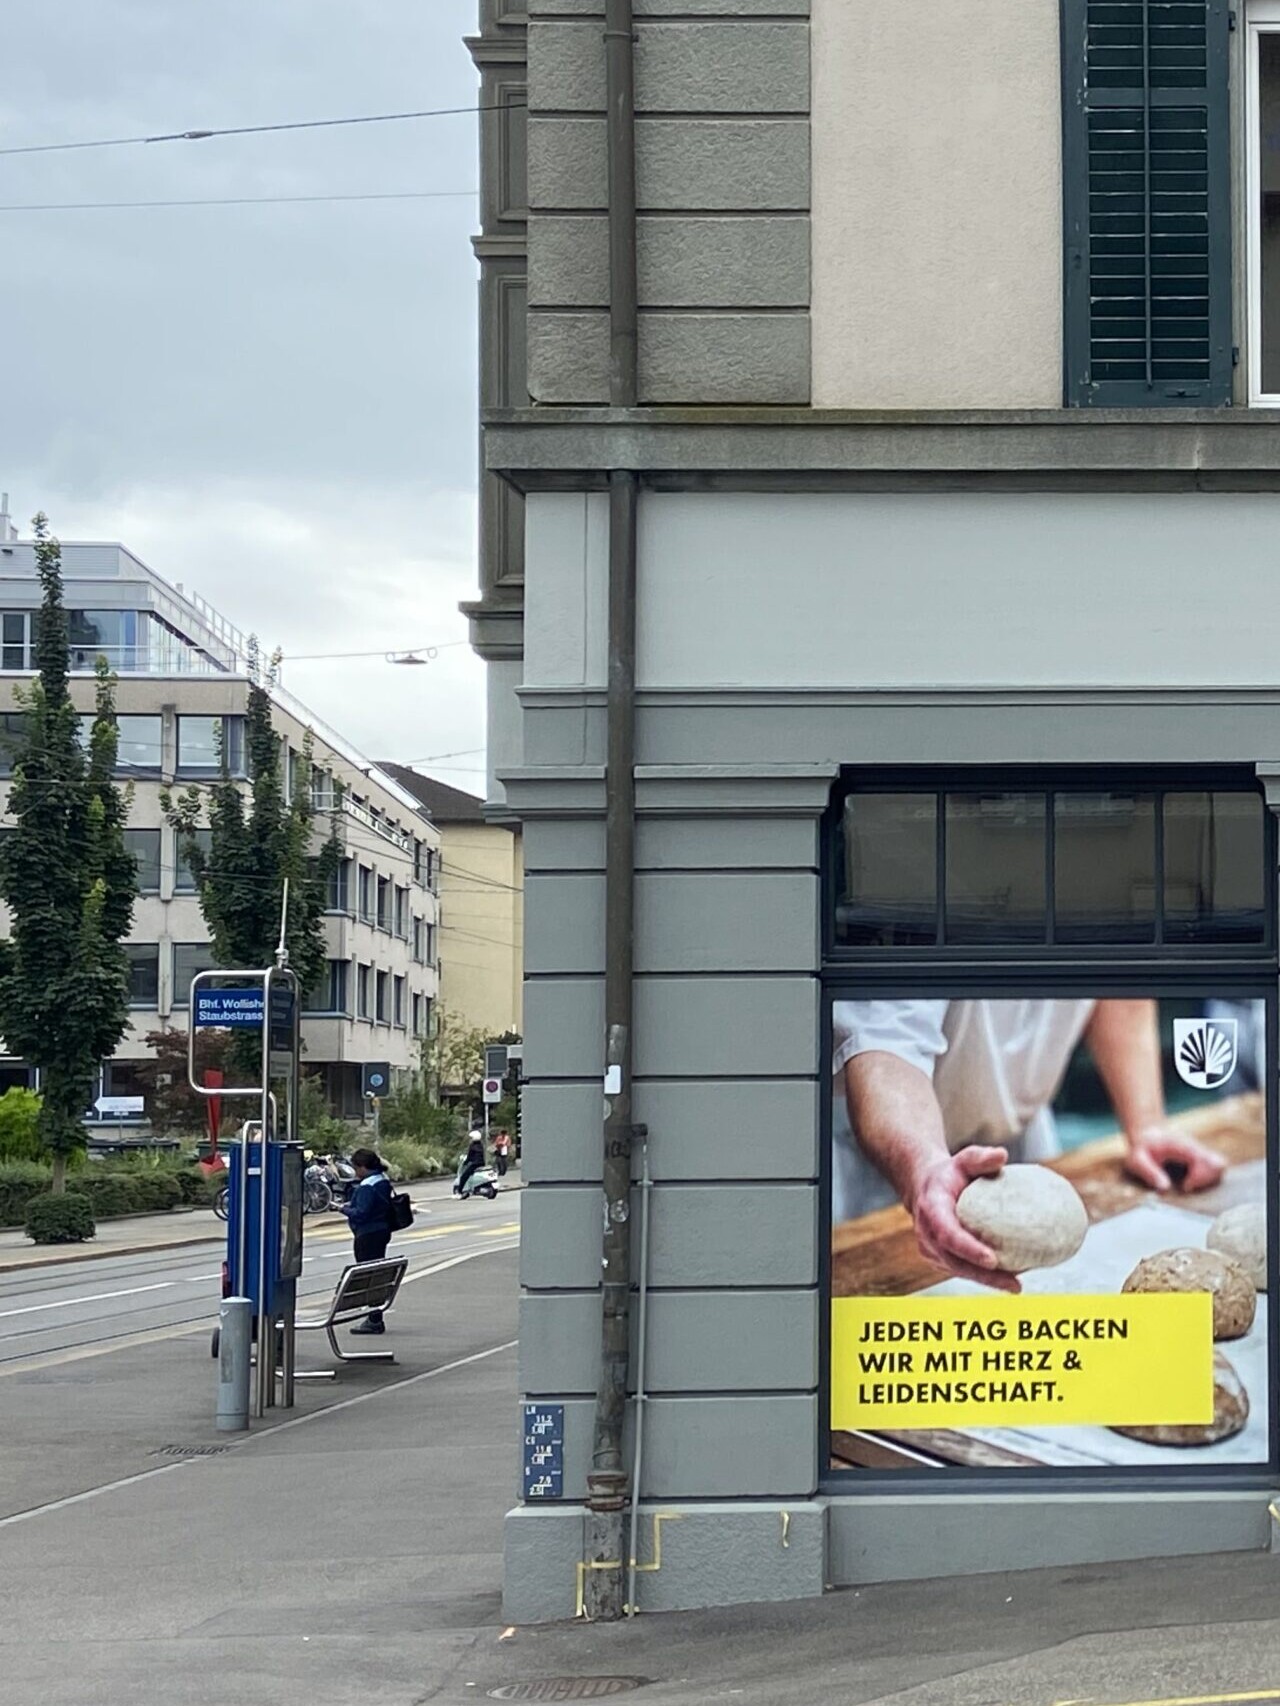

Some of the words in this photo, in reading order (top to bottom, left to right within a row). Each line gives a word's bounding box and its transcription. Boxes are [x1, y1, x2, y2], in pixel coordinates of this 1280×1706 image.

[198, 998, 221, 1010] Bhf.
[198, 1010, 264, 1022] Staubstrass
[858, 1321, 943, 1343] JEDEN
[952, 1319, 1008, 1341] TAG
[1018, 1318, 1128, 1341] BACKEN
[858, 1352, 914, 1374] WIR
[924, 1351, 973, 1373] MIT
[982, 1350, 1052, 1372] HERZ
[1062, 1349, 1082, 1371] &
[858, 1381, 1064, 1405] LEIDENSCHAFT.
